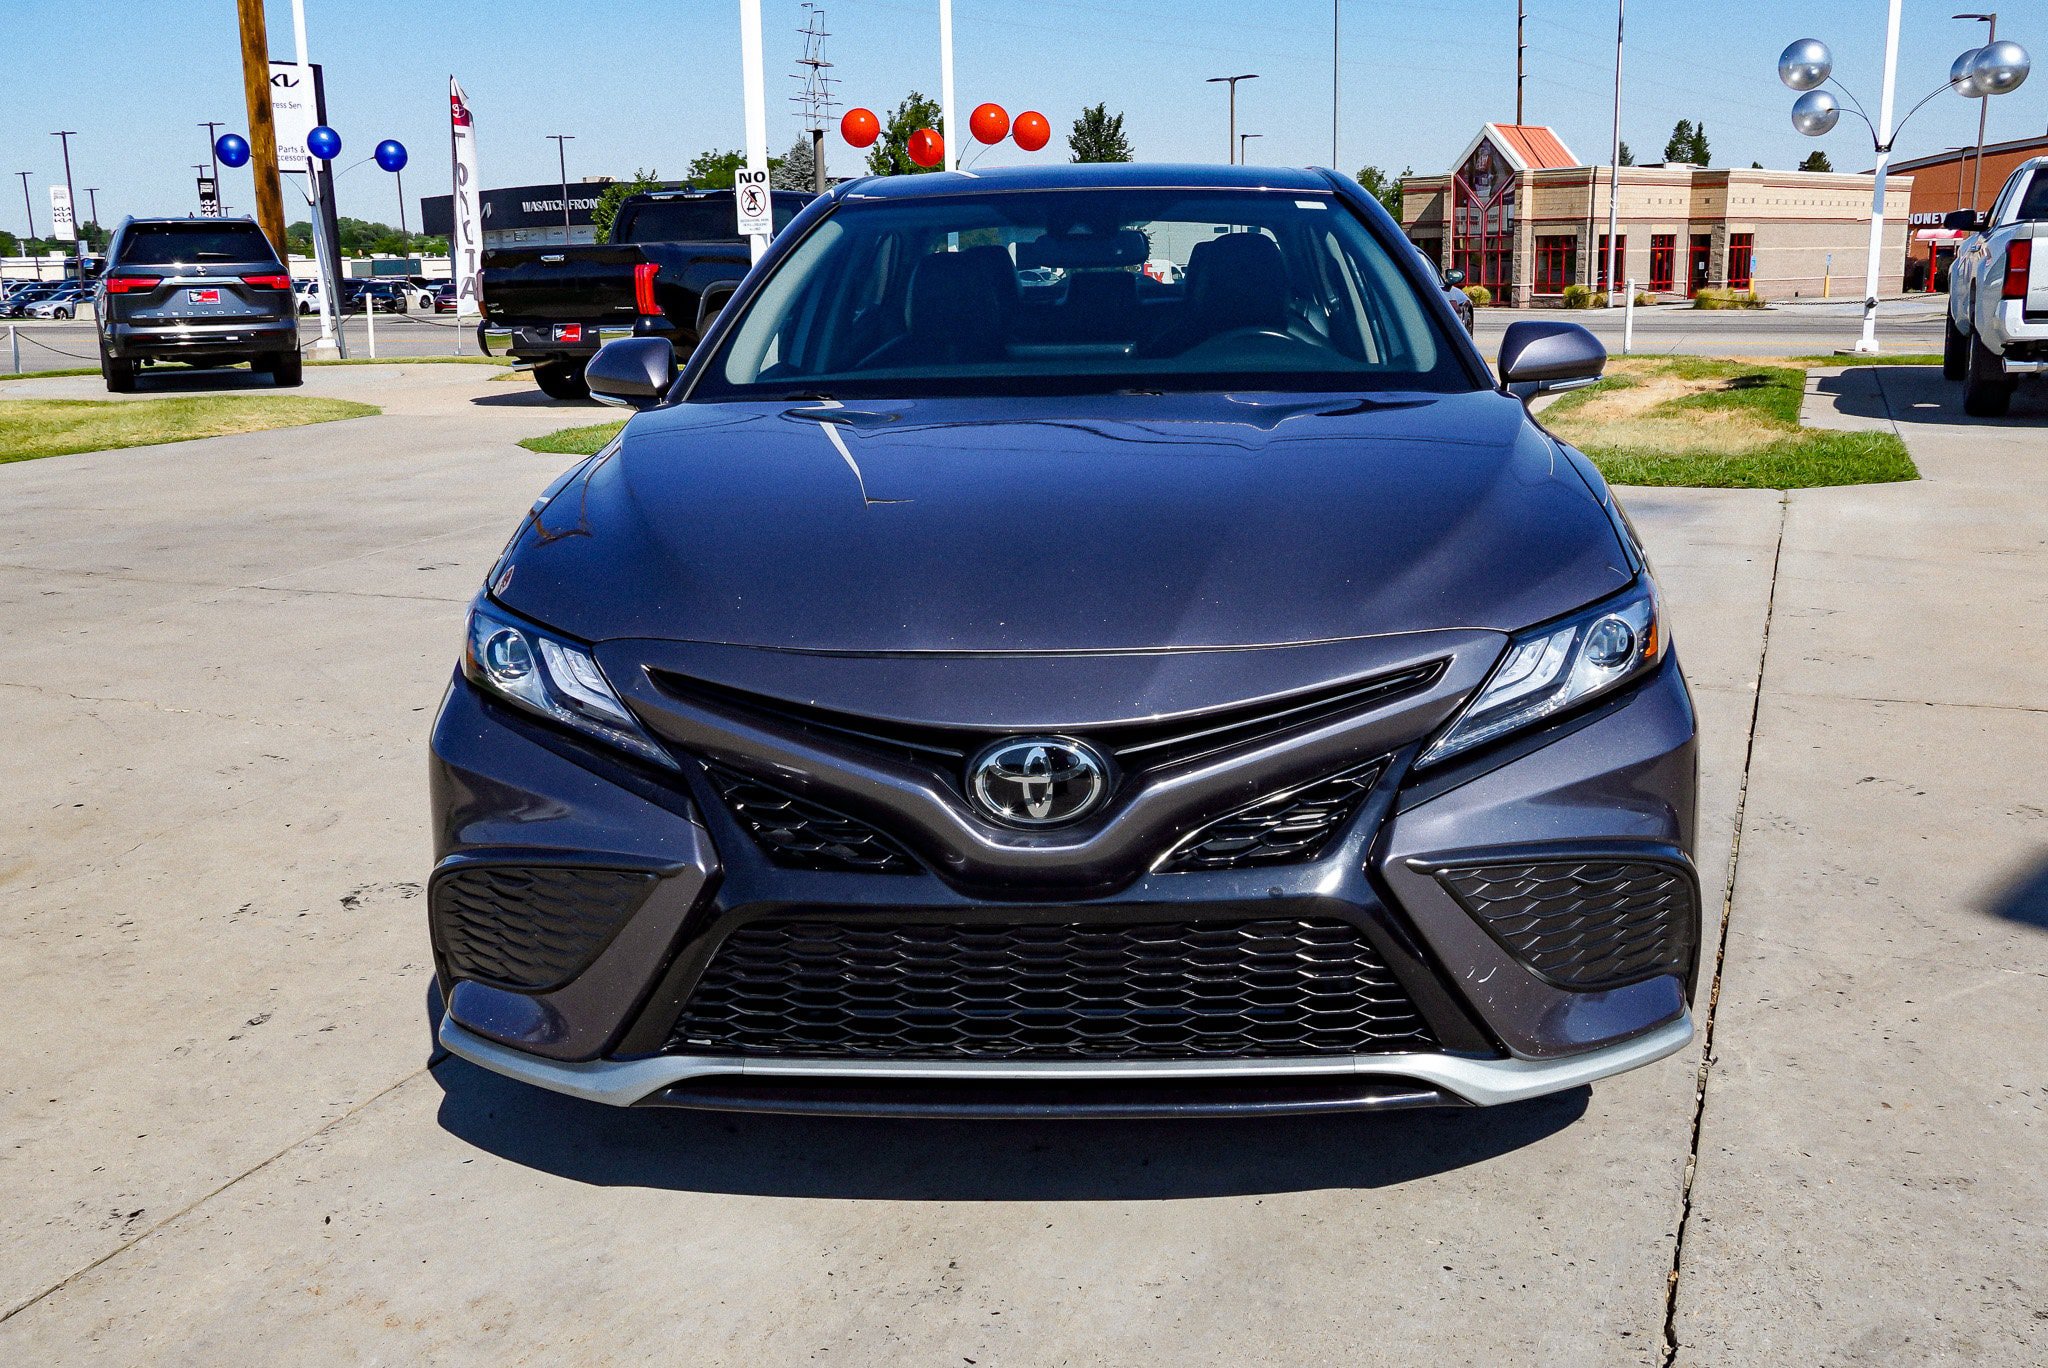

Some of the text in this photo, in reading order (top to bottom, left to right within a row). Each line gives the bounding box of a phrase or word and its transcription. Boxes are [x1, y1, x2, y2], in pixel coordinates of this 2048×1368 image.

[278, 145, 306, 153] Parts &
[738, 171, 766, 184] NO
[522, 199, 566, 212] WASATCH
